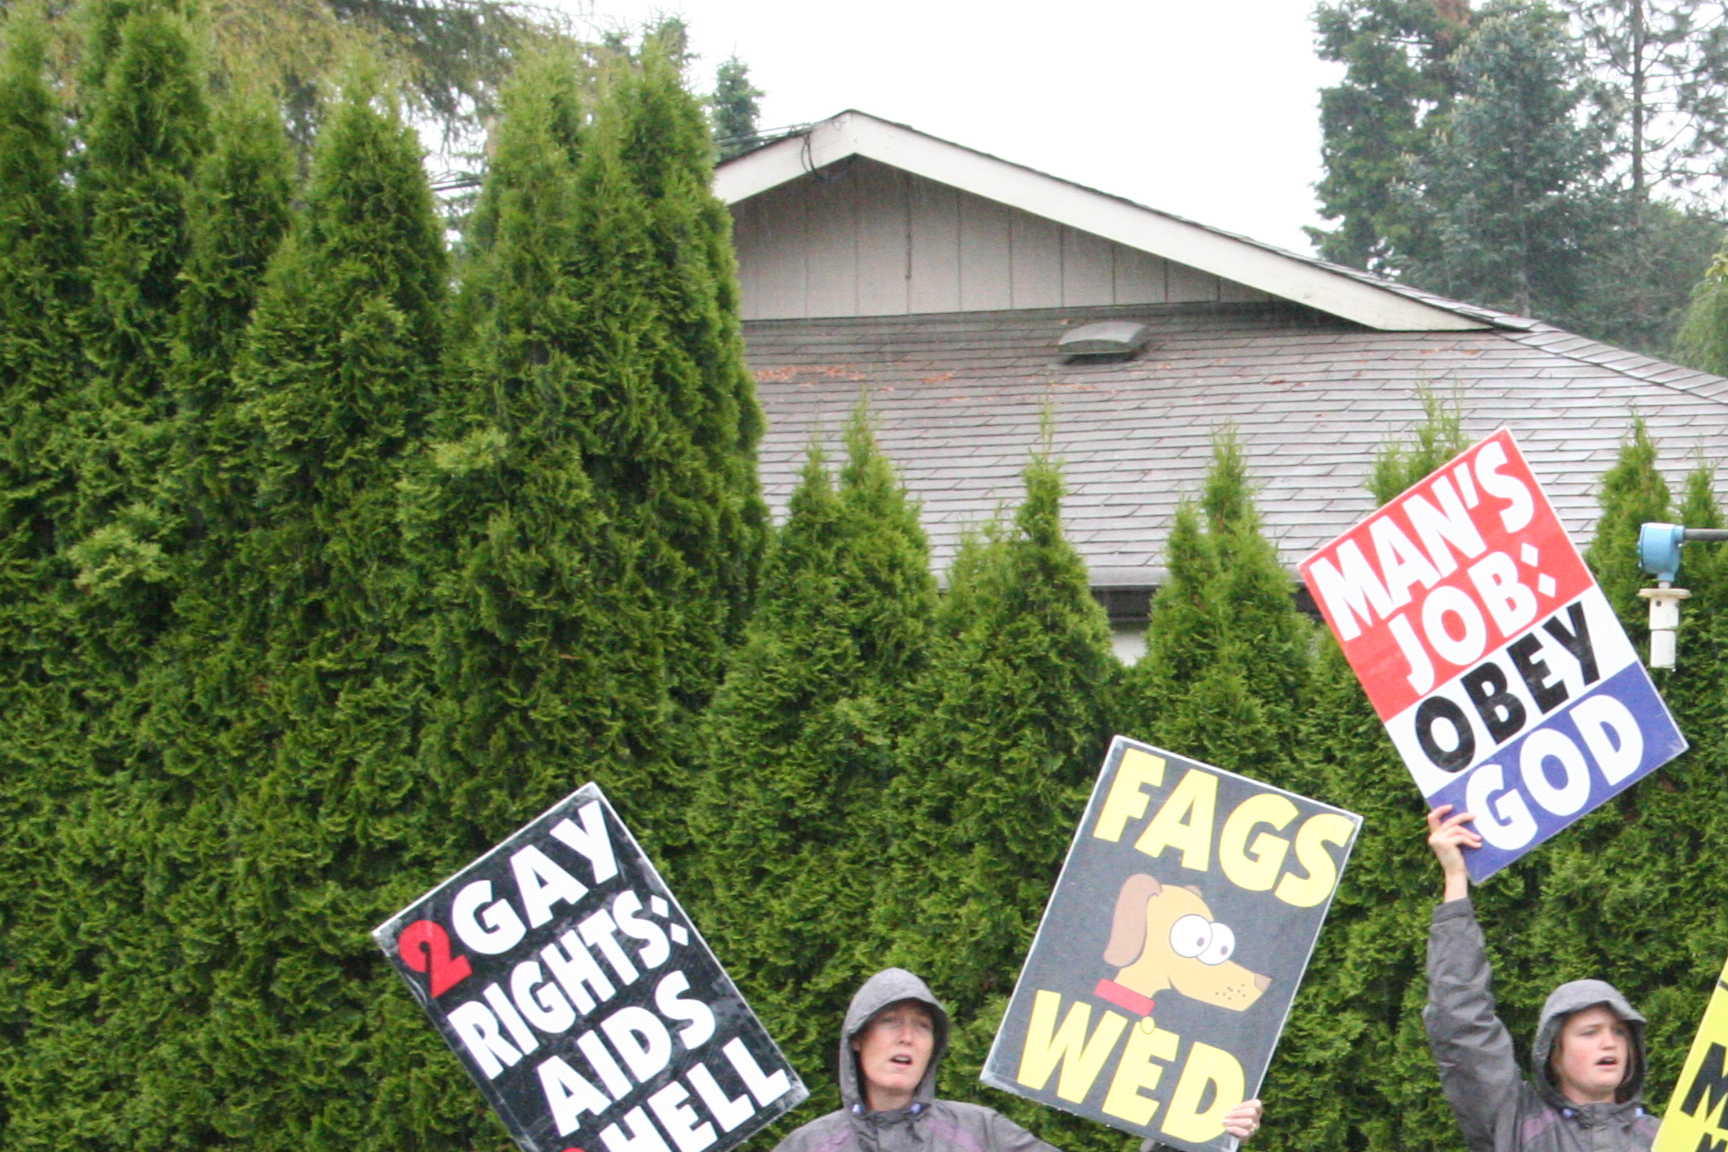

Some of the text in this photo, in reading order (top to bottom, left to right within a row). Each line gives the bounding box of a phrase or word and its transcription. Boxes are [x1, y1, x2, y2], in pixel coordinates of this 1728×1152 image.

[1309, 441, 1535, 642] MAN'S
[1388, 542, 1557, 696] JOB:
[1415, 600, 1601, 774] OBEY
[1093, 748, 1356, 908] FAGS
[1465, 694, 1644, 851] GOD
[447, 890, 689, 1081] RIGHTS:
[537, 970, 717, 1138] AIDS
[1017, 989, 1246, 1144] WED
